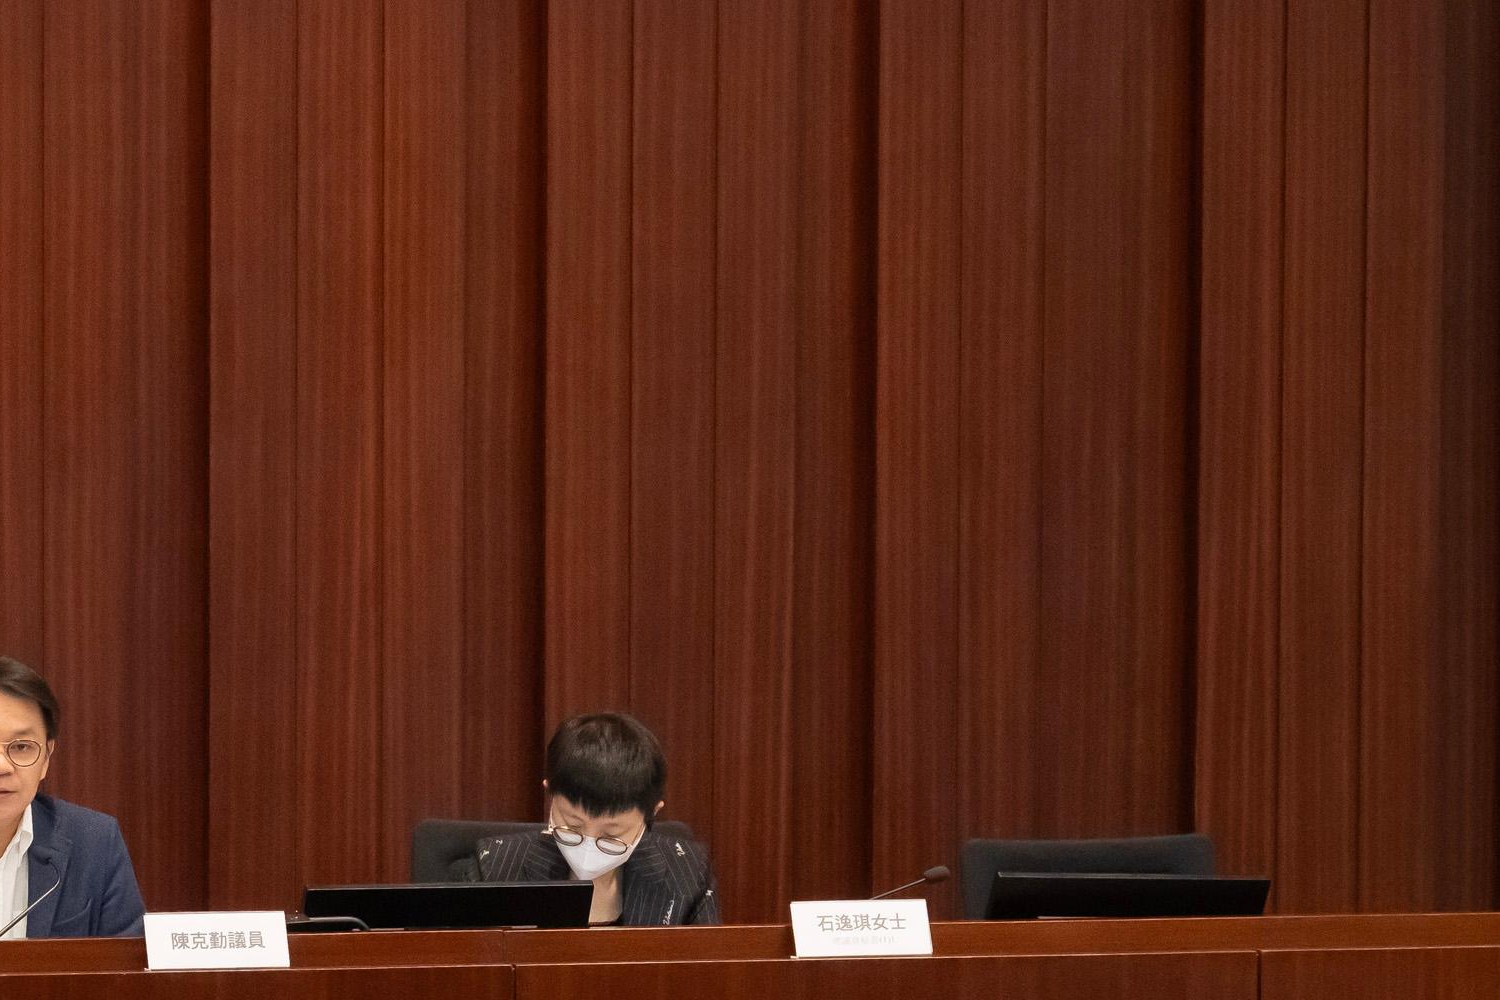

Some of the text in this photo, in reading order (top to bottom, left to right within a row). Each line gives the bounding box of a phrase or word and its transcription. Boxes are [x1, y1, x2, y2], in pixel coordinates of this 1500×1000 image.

[817, 913, 907, 932] 石逸琪女士
[171, 930, 266, 950] 陳克勤議員
